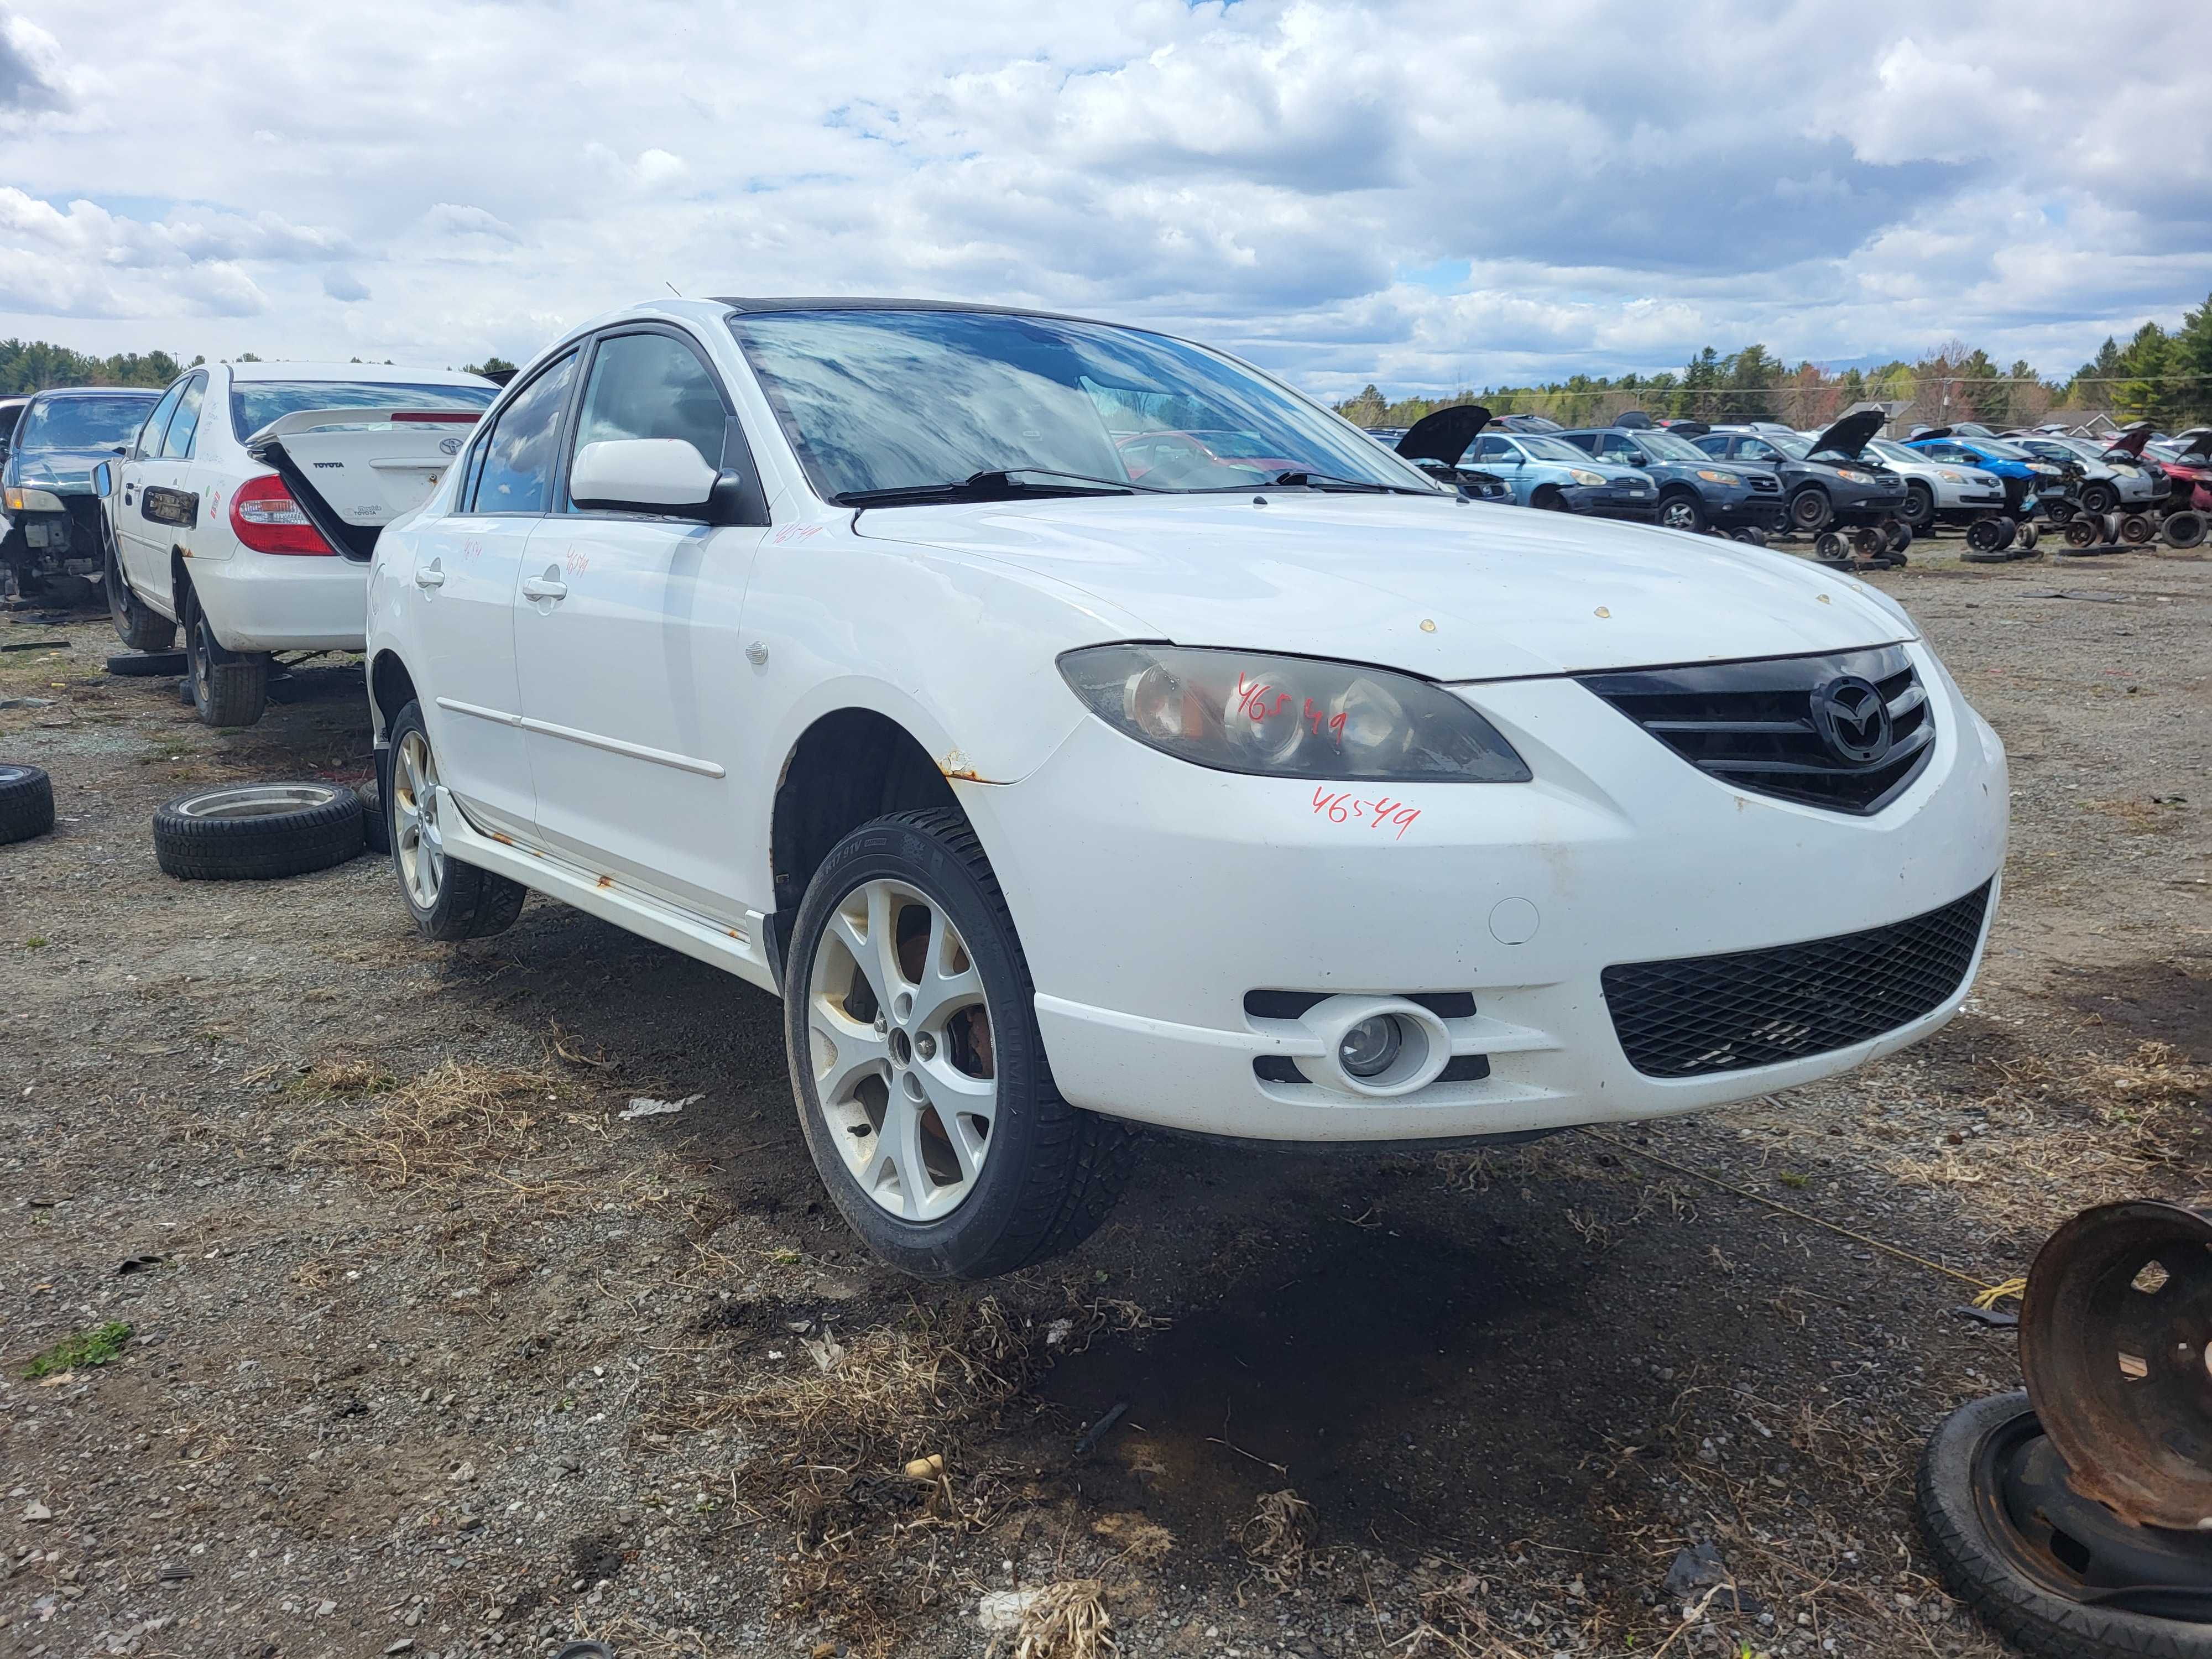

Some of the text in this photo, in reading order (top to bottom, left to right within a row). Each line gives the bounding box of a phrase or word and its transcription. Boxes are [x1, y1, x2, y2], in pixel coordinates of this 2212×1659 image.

[772, 523, 823, 544] 46549
[566, 542, 589, 578] 46549
[1238, 672, 1347, 745] 46549
[1312, 786, 1422, 841] 46549
[843, 839, 863, 859] 91V
